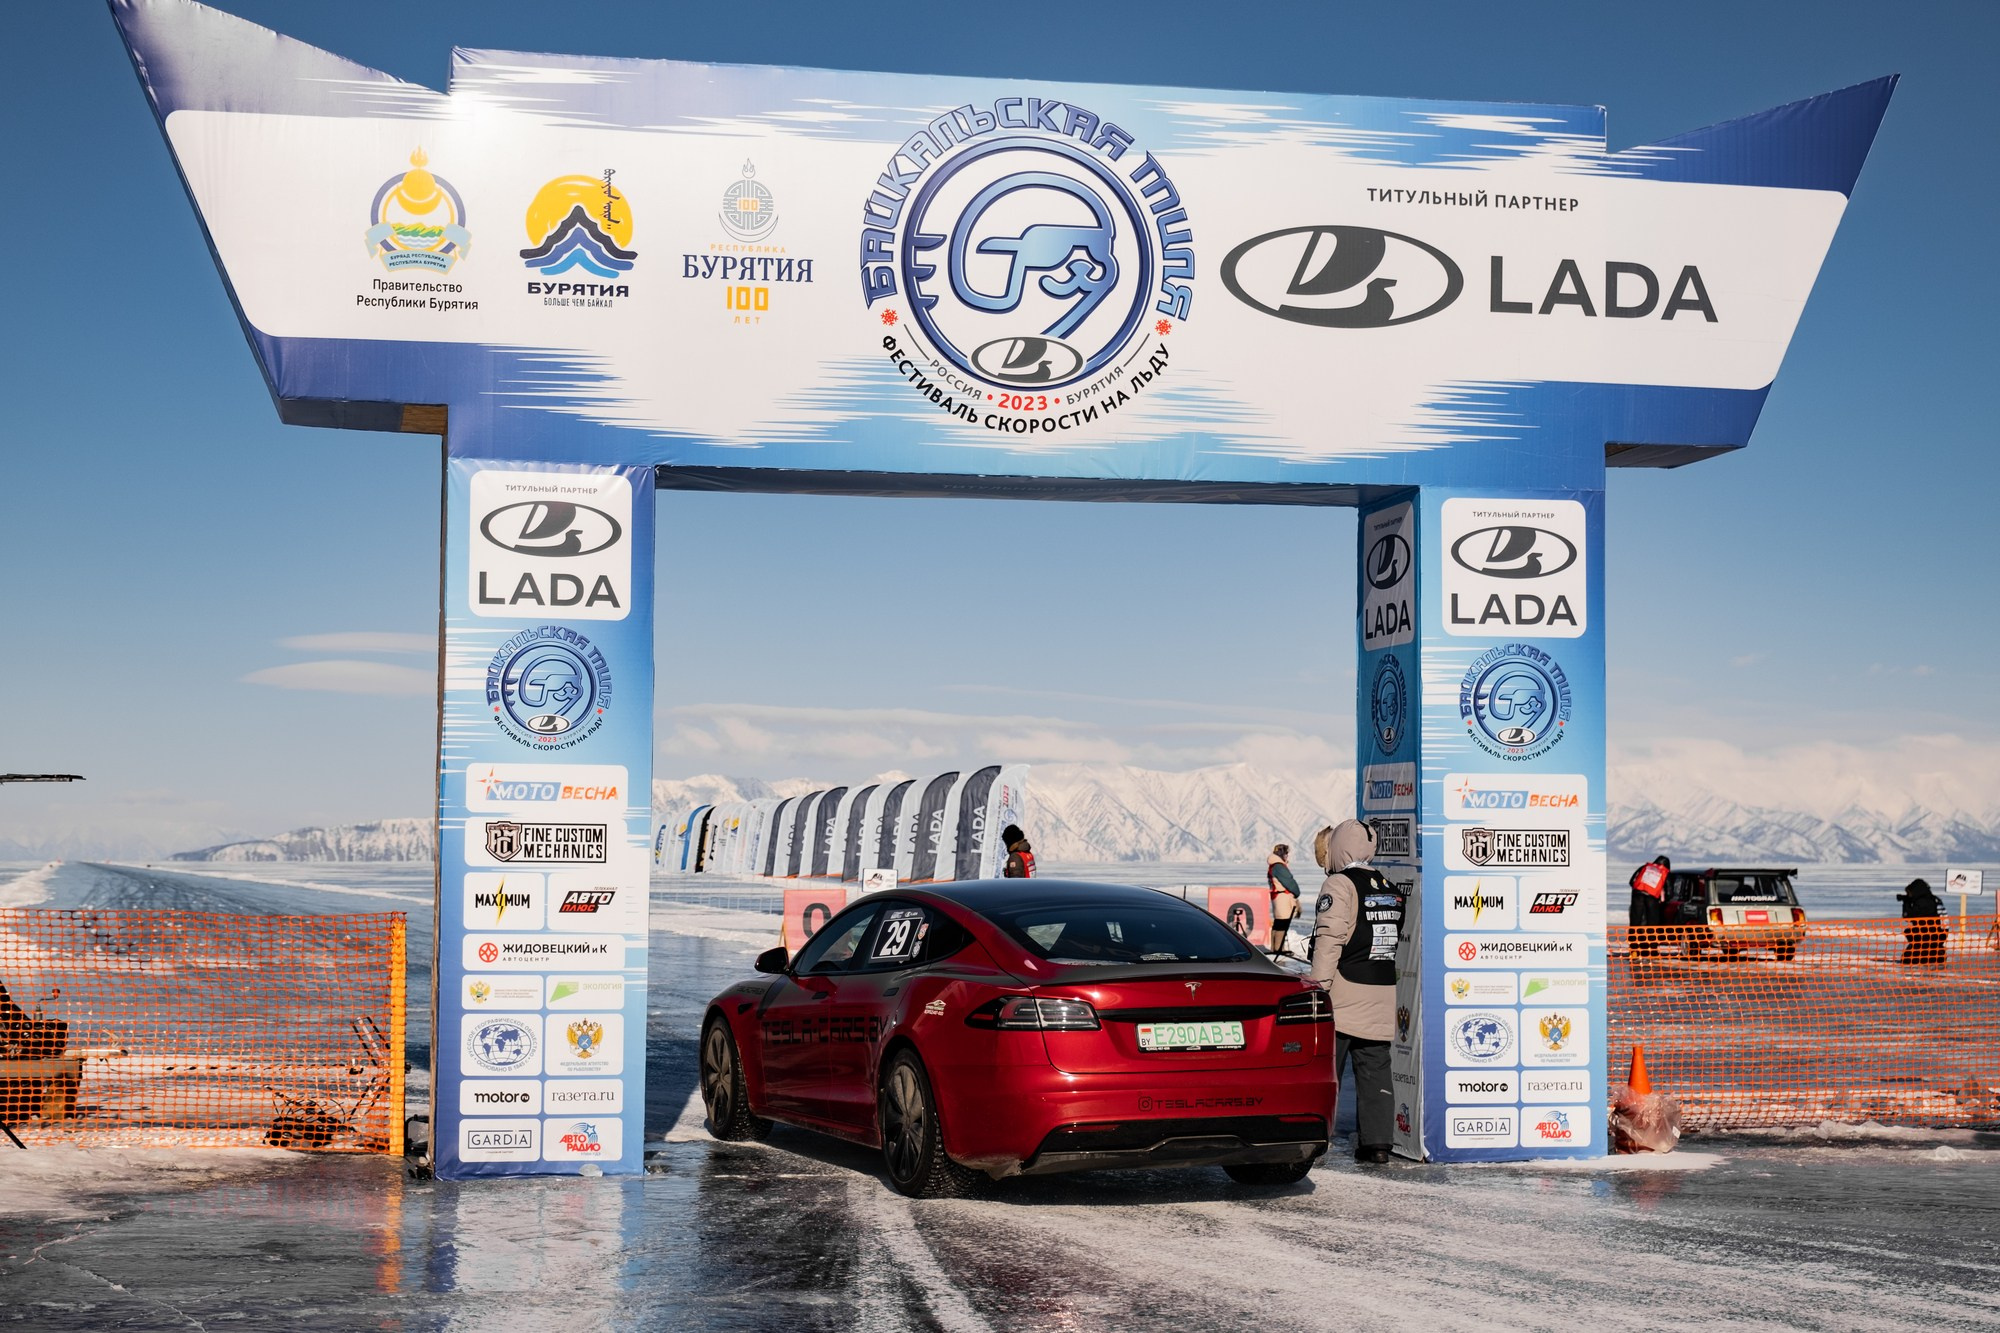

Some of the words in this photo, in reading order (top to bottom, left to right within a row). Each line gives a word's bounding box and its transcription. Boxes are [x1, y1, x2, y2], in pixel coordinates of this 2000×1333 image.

[860, 97, 1135, 309] БАЙКАЛЬСКАЯ
[1367, 188, 1488, 208] ТИТУЛЬНЫЙ
[1495, 194, 1579, 212] ПАРТНЕР
[709, 243, 787, 254] РЕСПУБЛИКА
[682, 254, 814, 283] БУРЯТИЯ
[372, 278, 463, 293] Правительство
[527, 282, 629, 298] БУРЯТИЯ
[1490, 255, 1719, 323] LADA
[356, 294, 427, 310] Республики
[429, 296, 479, 312] Бурятия
[543, 298, 569, 307] БОЛЬШЕ
[572, 298, 586, 307] ЧЕМ
[587, 297, 613, 308] БАЙКАЛ
[726, 286, 769, 312] 100
[734, 316, 761, 325] ЛЕТ
[882, 335, 979, 424] ФЕСТИВАЛЬ
[984, 406, 1099, 434] СКОРОСТИ
[1102, 391, 1131, 416] НА
[1132, 342, 1171, 394] ЛЬДУ
[930, 359, 982, 400] РОССИЯ
[998, 393, 1048, 411] 2023
[1066, 365, 1125, 406] БУРЯТИЯ
[505, 484, 558, 494] ТИТУЛЬНЫЙ
[560, 486, 598, 495] ПАРТНЕР
[479, 571, 621, 609] LADA
[1451, 593, 1577, 626] LADA
[1365, 599, 1411, 641] LADA
[485, 625, 591, 706] БАЙКАЛЬСКАЯ
[1459, 643, 1551, 720] БАЙКАЛЬСКАЯ
[493, 715, 531, 748] ФЕСТИВАЛЬ
[532, 739, 577, 751] СКОРОСТИ
[577, 734, 588, 744] НА
[587, 716, 604, 738] ЛЬДУ
[1467, 728, 1502, 760] ФЕСТИВАЛЬ
[1503, 751, 1542, 762] СКОРОСТИ
[1541, 745, 1551, 755] НА
[1550, 729, 1565, 749] ЛЬДУ
[497, 783, 555, 800] МОТО
[561, 786, 619, 800] ВЕСНА
[1472, 791, 1524, 808] МОТО
[1529, 794, 1579, 808] ВЕСНА
[524, 827, 552, 842] FINE
[555, 828, 603, 843] CUSTOM
[927, 809, 944, 854] LADA
[971, 805, 985, 854] LADA
[1496, 833, 1521, 848] FINE
[1525, 834, 1567, 848] CUSTOM
[524, 844, 603, 859] MECHANICS
[1496, 849, 1567, 863] MECHANICS
[566, 892, 612, 905] АВТО
[1534, 894, 1577, 906] АВТО
[562, 904, 596, 912] ПЛЮС
[1532, 905, 1561, 913] ПЛЮС
[879, 919, 911, 956] 29
[503, 941, 590, 956] ЖИДОВЕЦКИЙ
[600, 945, 607, 953] К
[1480, 940, 1558, 954] ЖИДОВЕЦКИЙ
[1567, 943, 1573, 952] К
[582, 982, 623, 991] ЭКОЛОГИЯ
[466, 1029, 477, 1058] РУССКОЕ
[474, 1018, 524, 1032] ГЕОГРАФИЧЕСКОЕ
[1141, 1038, 1150, 1046] BY
[477, 1060, 507, 1073] ОСНОВАНО
[1458, 1081, 1499, 1092] motor
[1527, 1080, 1583, 1091] газета.ru
[474, 1092, 520, 1103] motor
[552, 1091, 615, 1102] газета.ru
[1456, 1119, 1508, 1133] GARDIA
[1534, 1122, 1559, 1131] АВТО
[471, 1132, 528, 1146] GARDIA
[559, 1134, 587, 1144] АВТО
[1541, 1130, 1572, 1139] РАДИО
[566, 1143, 601, 1152] РАДИО
